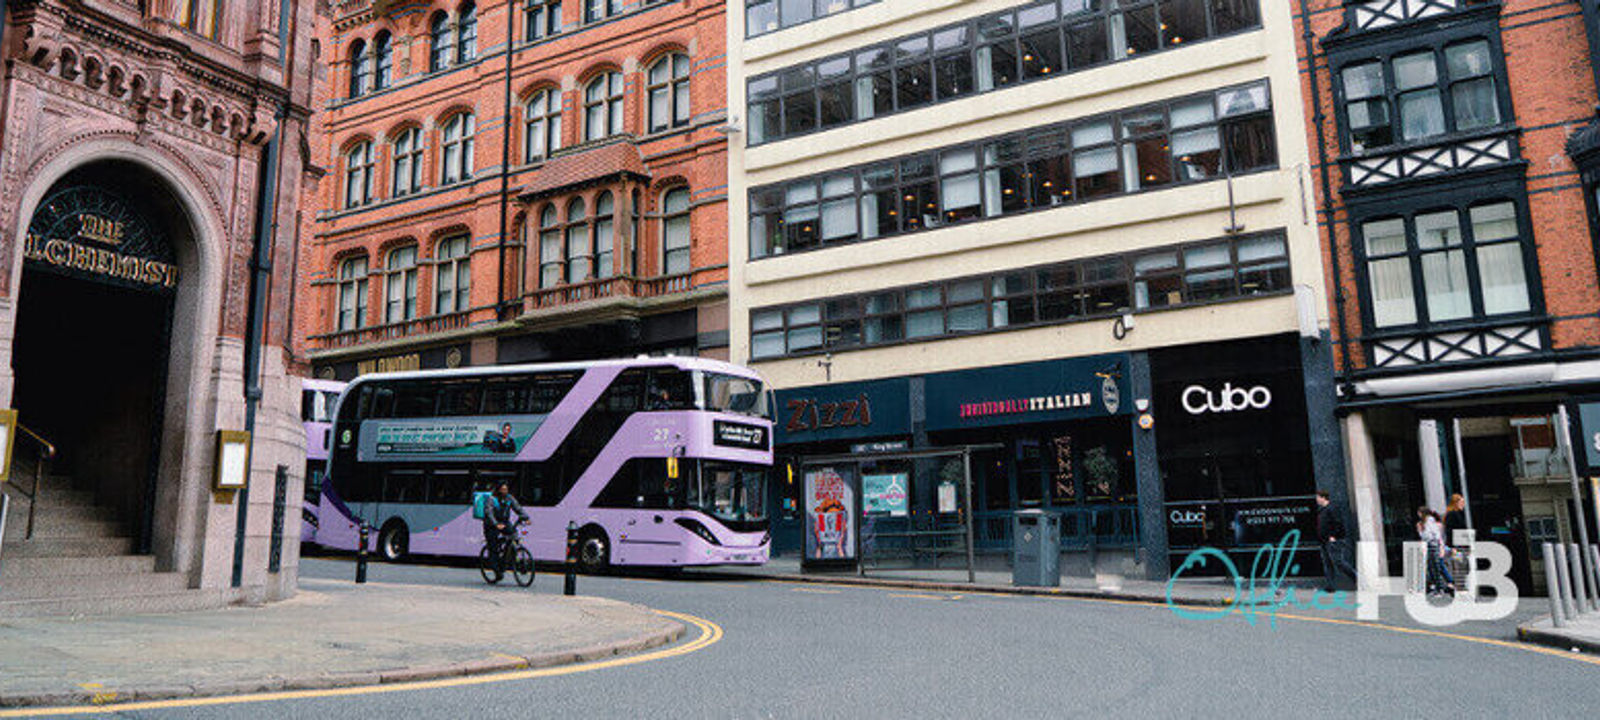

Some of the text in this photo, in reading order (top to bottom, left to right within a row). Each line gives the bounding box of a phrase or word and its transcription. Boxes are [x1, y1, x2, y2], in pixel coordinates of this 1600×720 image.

[78, 213, 125, 238] THE
[786, 393, 871, 432] Zizzi
[1182, 382, 1272, 415] Cubo
[1169, 509, 1205, 524] Cubo
